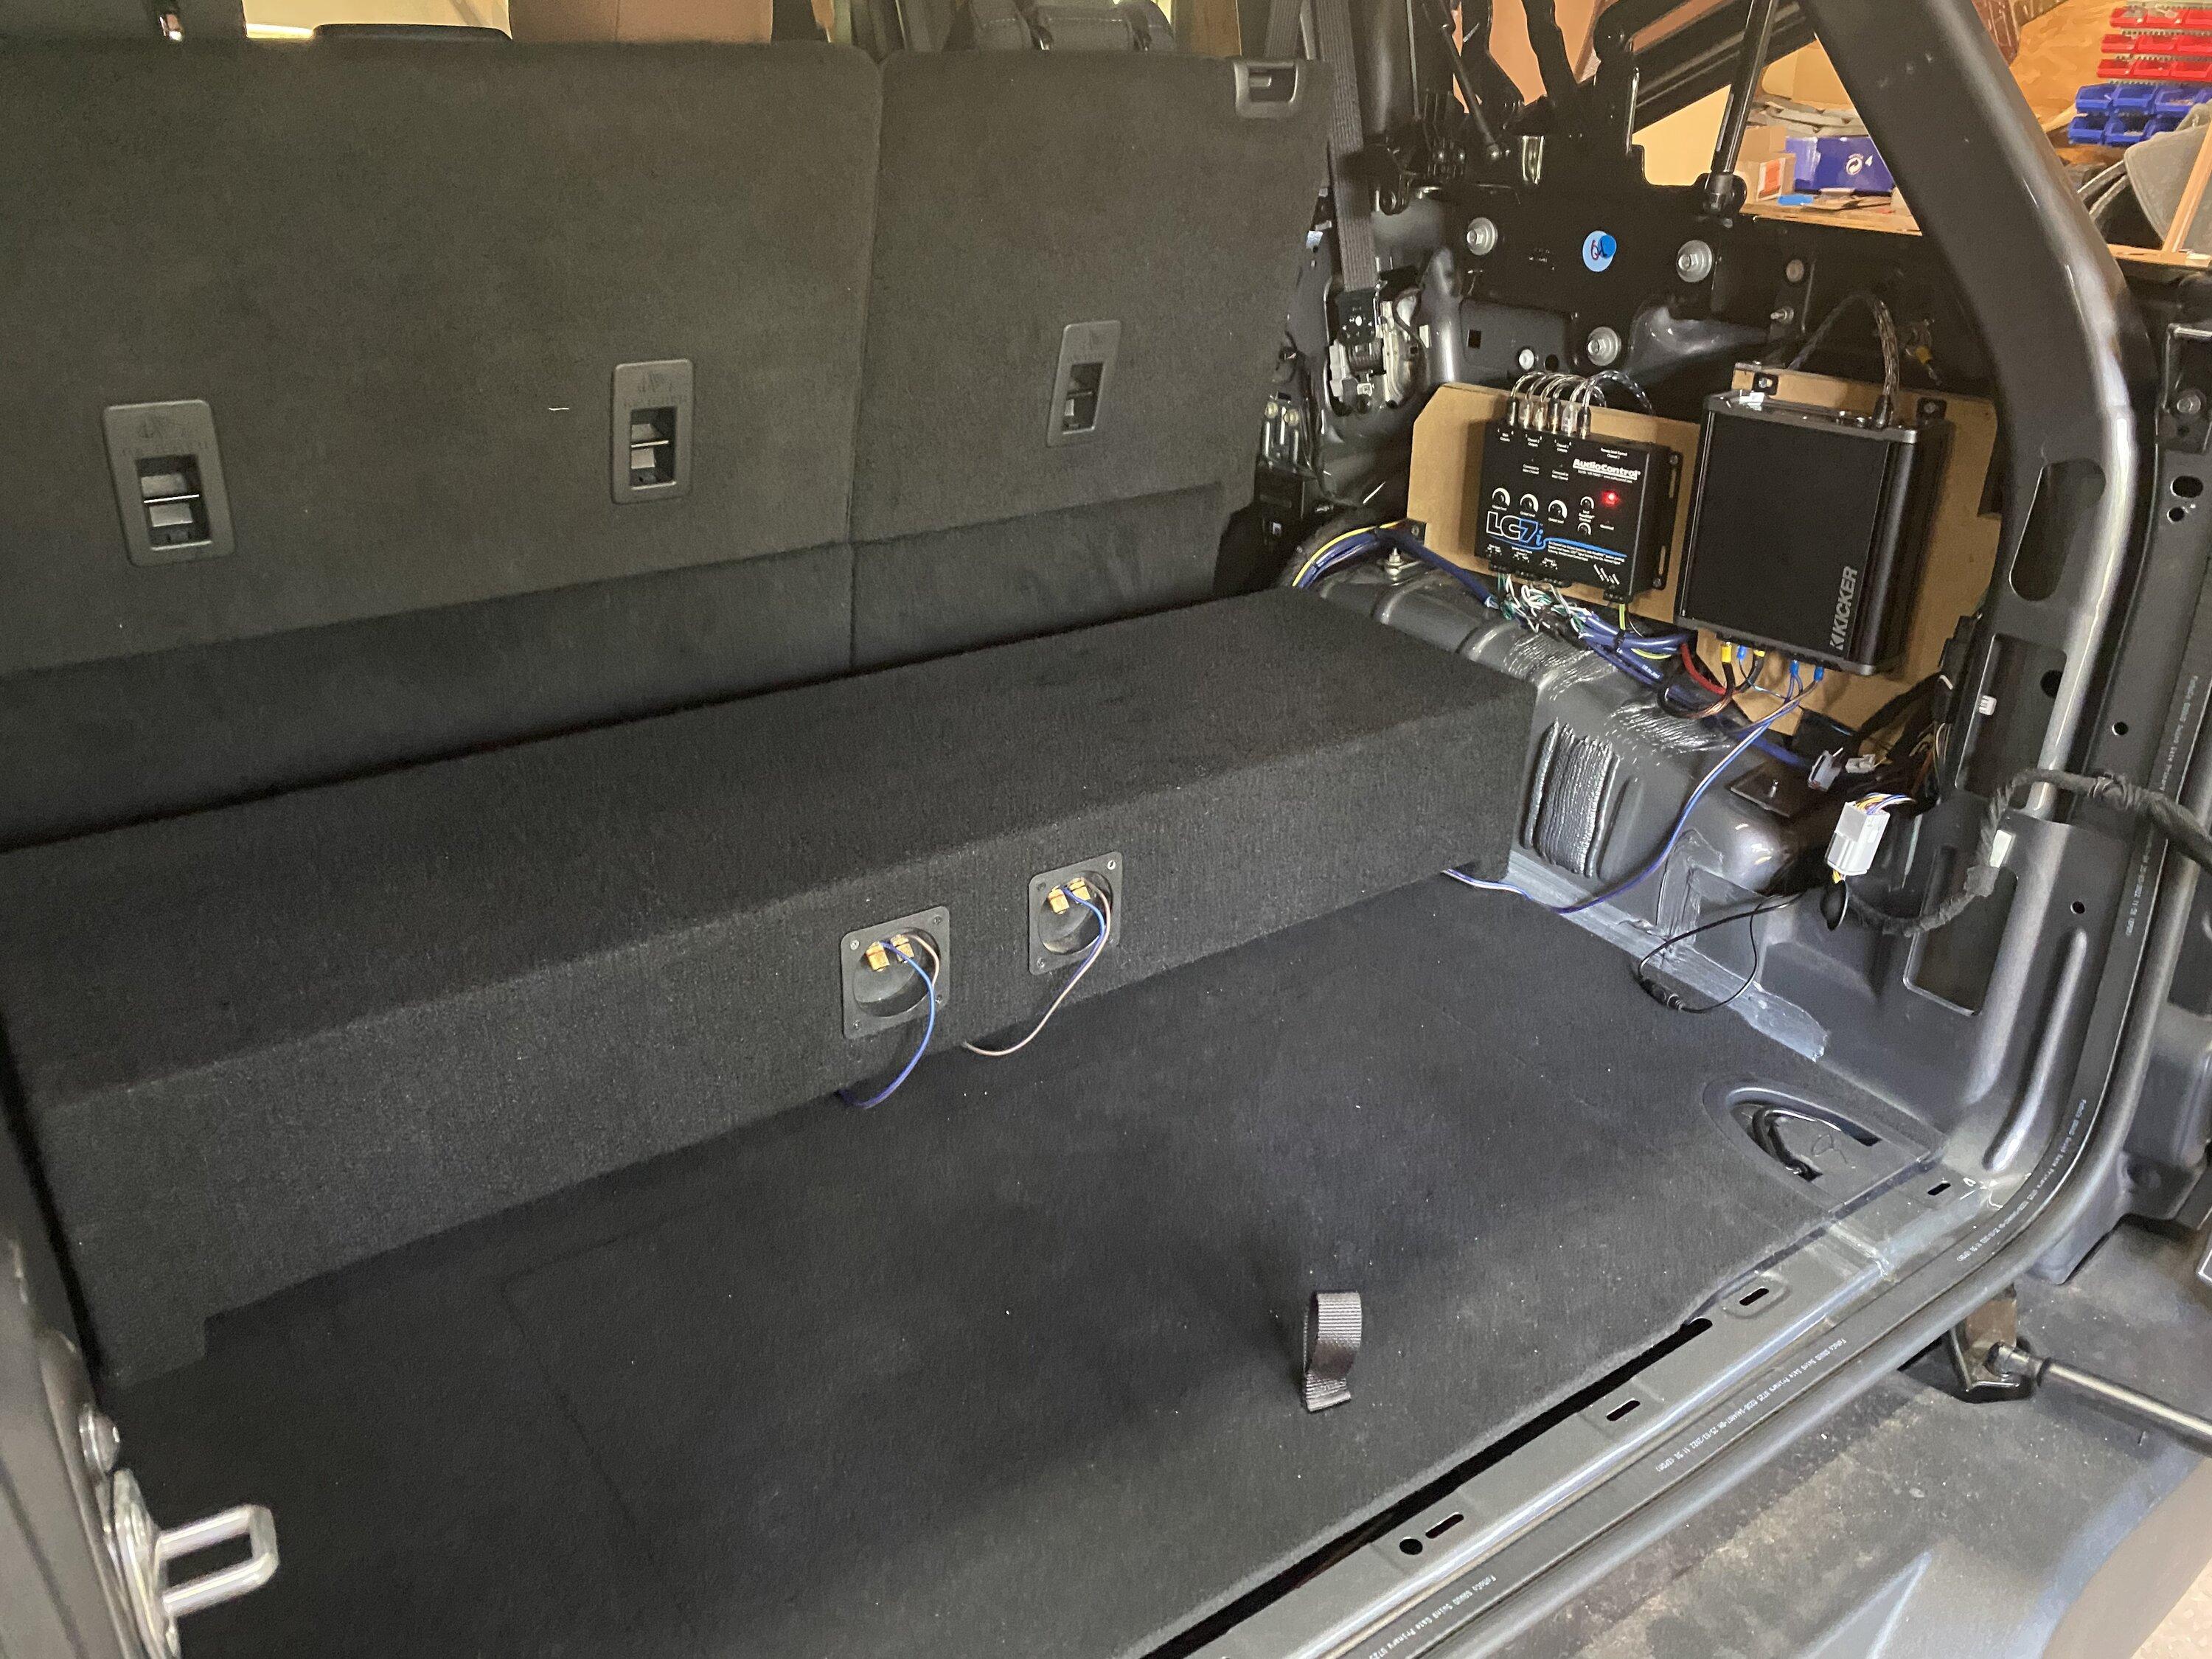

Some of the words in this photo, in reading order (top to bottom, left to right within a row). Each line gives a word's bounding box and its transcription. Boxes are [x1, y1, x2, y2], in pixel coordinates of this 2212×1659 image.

[1572, 458, 1638, 480] AudioControl
[1486, 510, 1543, 546] LC7i
[1832, 566, 1857, 636] KICKER
